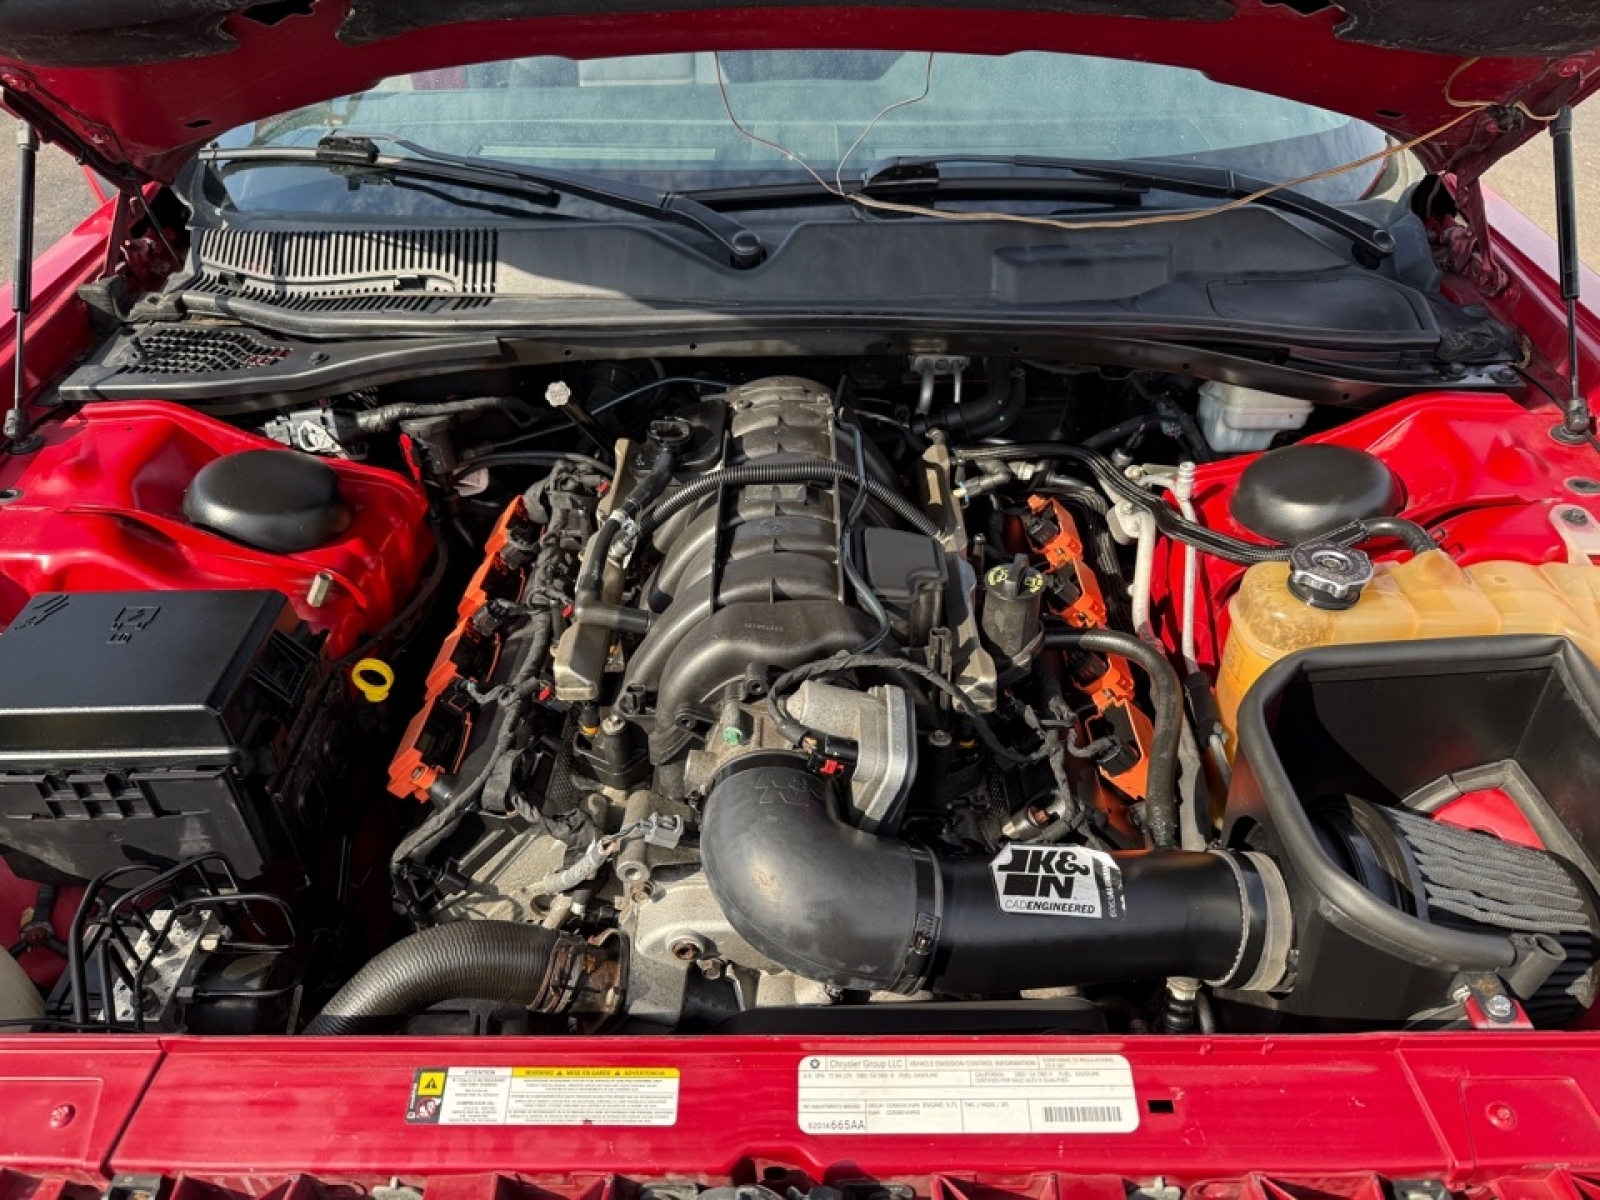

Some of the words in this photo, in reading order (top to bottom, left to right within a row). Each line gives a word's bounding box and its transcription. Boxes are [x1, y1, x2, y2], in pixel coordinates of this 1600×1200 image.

[830, 1060, 861, 1070] Chrysler
[863, 1060, 886, 1070] Group
[888, 1060, 902, 1068] LLC
